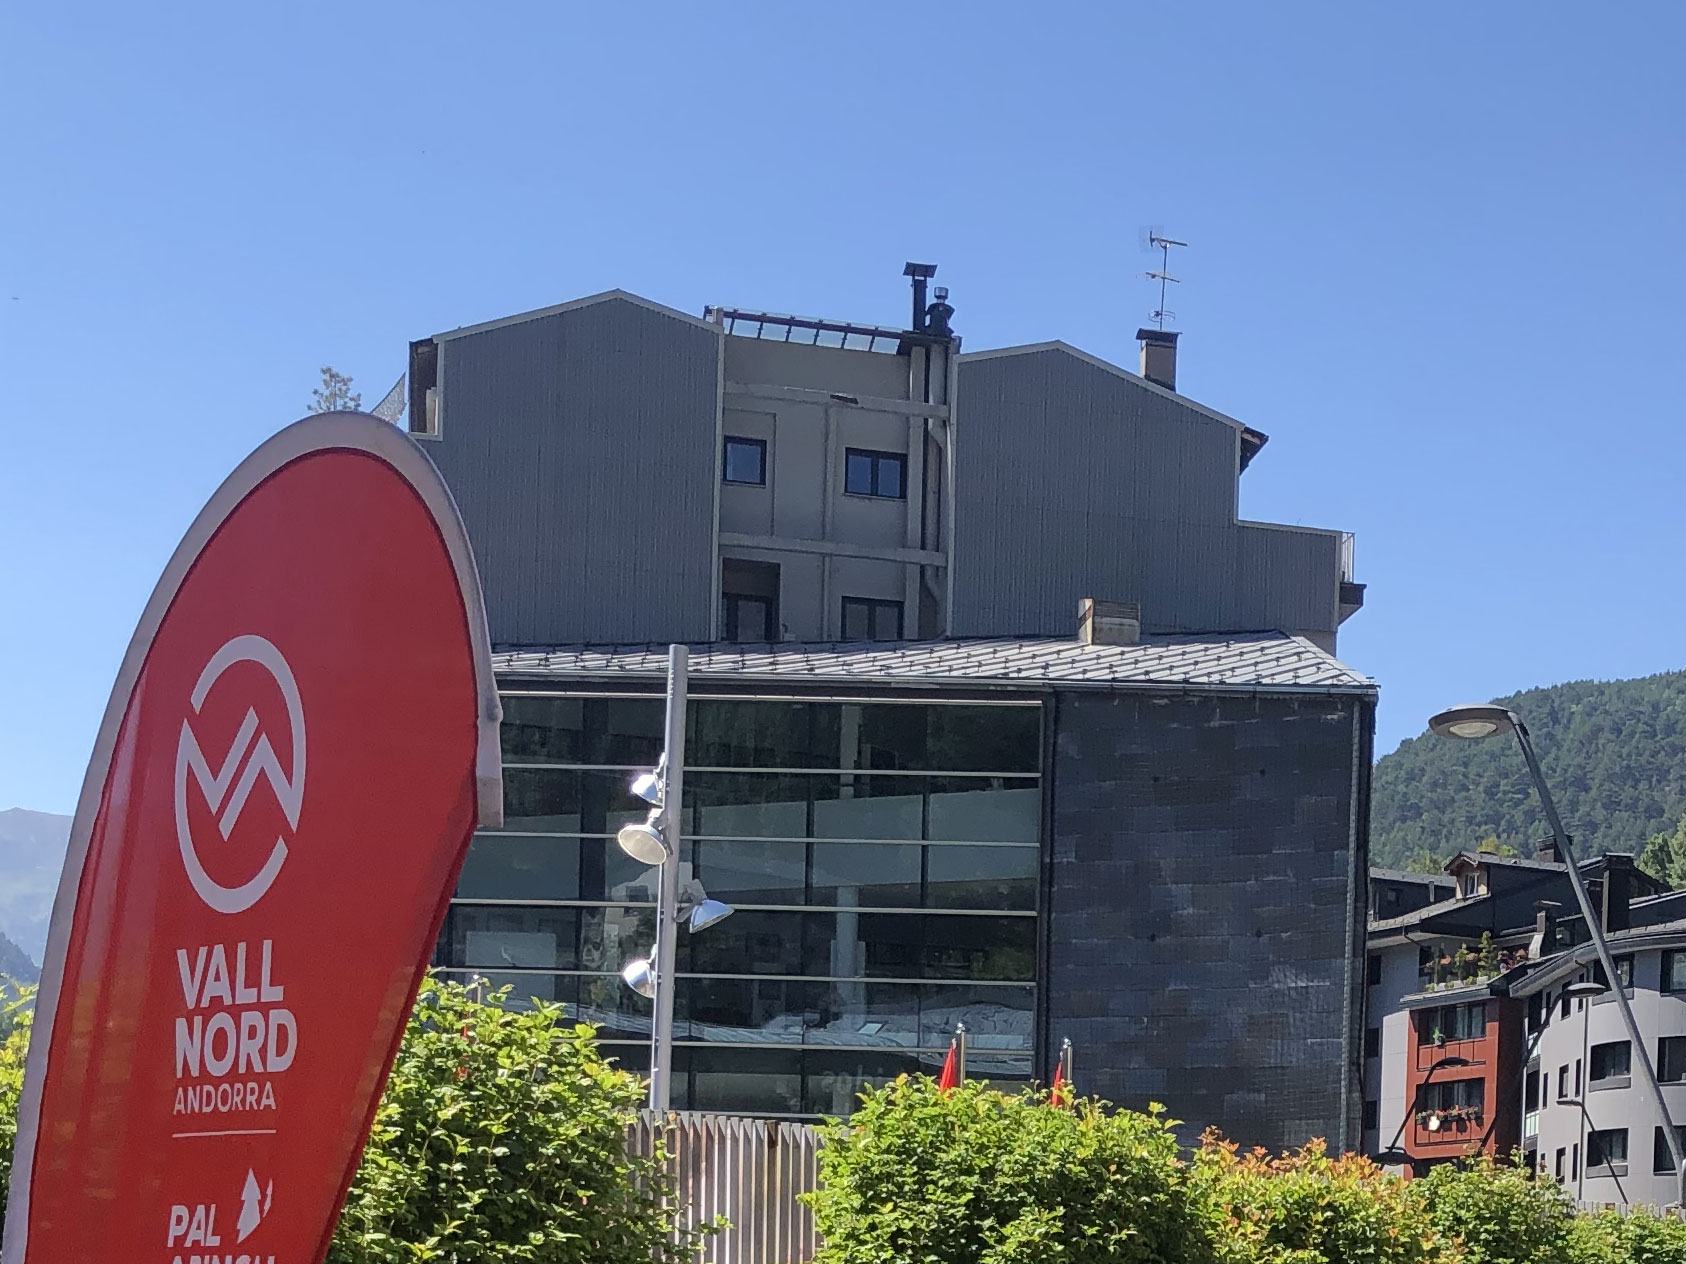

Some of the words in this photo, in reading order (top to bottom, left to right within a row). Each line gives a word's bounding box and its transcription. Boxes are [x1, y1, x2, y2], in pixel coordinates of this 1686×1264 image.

[177, 940, 284, 1010] VALL
[175, 1009, 298, 1079] NORD
[173, 1081, 277, 1116] ANDORRA
[167, 1203, 221, 1248] PAL
